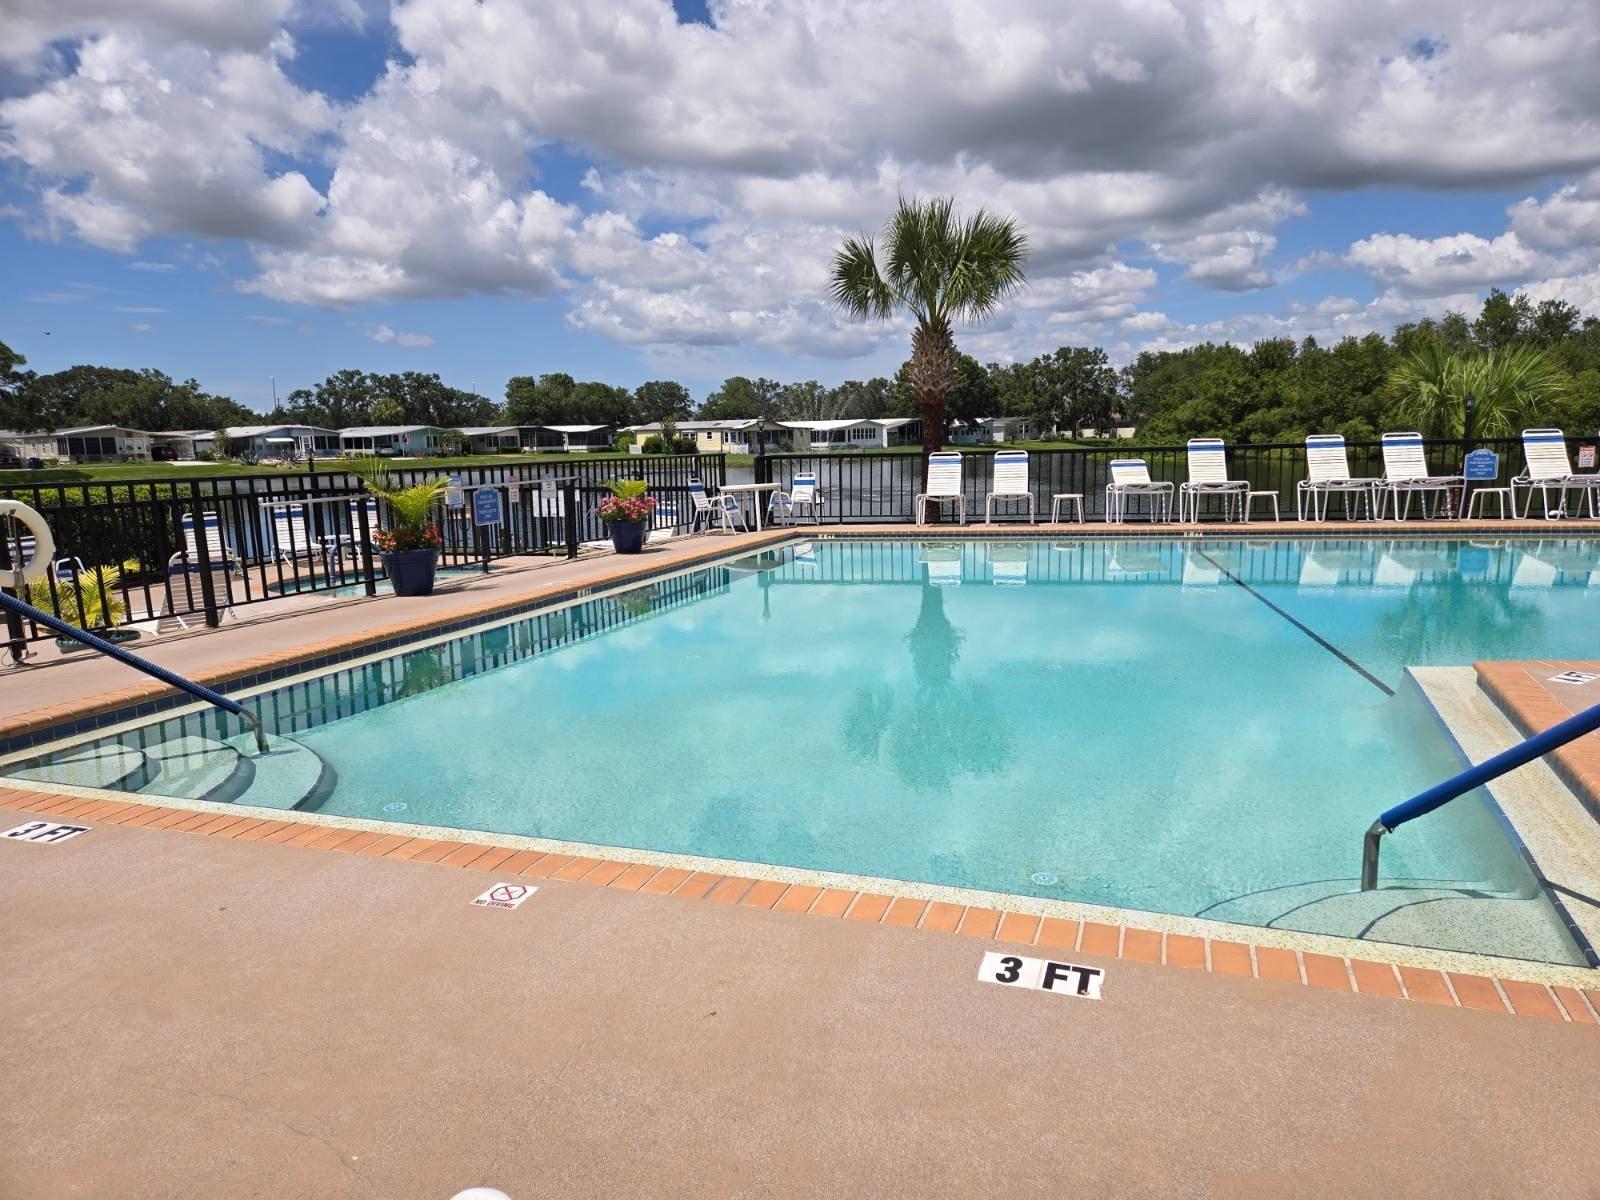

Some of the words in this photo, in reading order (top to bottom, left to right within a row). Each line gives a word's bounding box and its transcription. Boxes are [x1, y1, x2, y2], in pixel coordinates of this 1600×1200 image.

[8, 823, 48, 837] 3
[30, 825, 89, 842] FT
[486, 900, 516, 909] DIVING
[995, 956, 1024, 983] 3
[1042, 962, 1101, 996] FT
